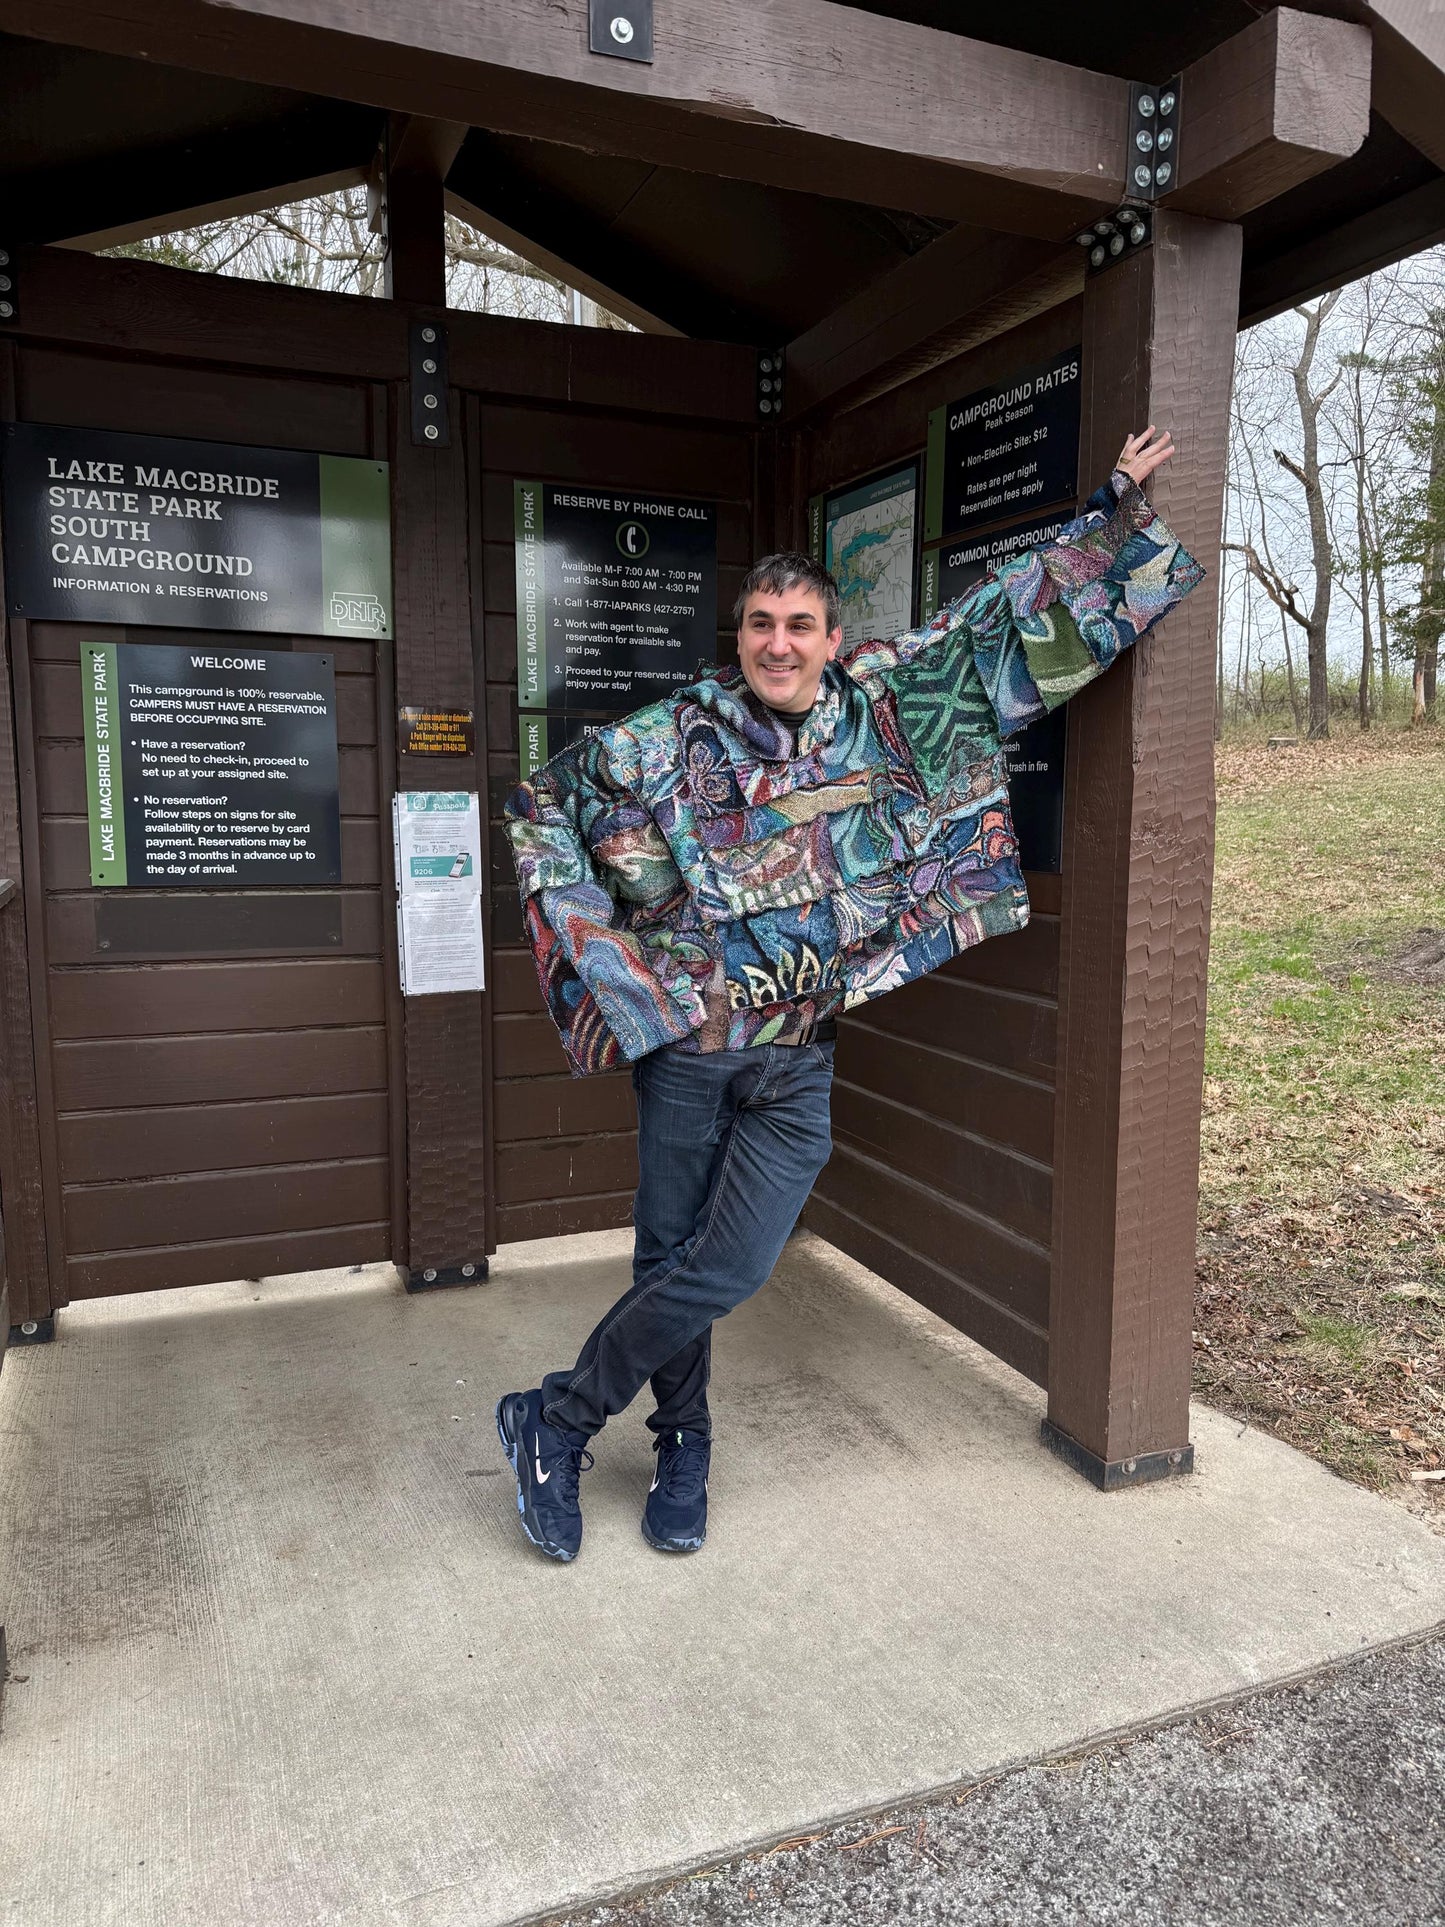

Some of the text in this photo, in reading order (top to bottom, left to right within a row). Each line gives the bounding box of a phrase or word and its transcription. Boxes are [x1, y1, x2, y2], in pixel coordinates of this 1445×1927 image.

[950, 362, 1078, 431] CAMPGROUND RATES
[985, 404, 1033, 431] Peak Season
[967, 427, 1048, 467] Non-Electric Site: $12
[48, 458, 279, 499] LAKE MACBRIDE
[967, 462, 1037, 495] Rates are per night
[49, 487, 222, 520] STATE PARK
[960, 479, 1043, 516] Reservation fees apply
[553, 494, 707, 520] RESERVE BY PHONE CALL
[50, 515, 151, 542] SOUTH
[51, 543, 252, 577] CAMPGROUND
[949, 544, 989, 567] COMMON
[561, 562, 602, 573] Available
[605, 564, 622, 574] M-F
[625, 566, 643, 577] 7:00
[645, 567, 659, 577] AM
[668, 569, 686, 579] 7:00
[688, 571, 702, 581] PM
[52, 578, 268, 602] INFORMATION & RESERVATIONS
[563, 575, 580, 585] and
[584, 577, 619, 588] Sat-Sun
[622, 579, 640, 589] 8:00
[642, 580, 656, 590] AM
[665, 582, 684, 592] 4:30
[686, 583, 699, 593] PM
[926, 562, 934, 602] PARK
[524, 491, 537, 692] LAKE MACBRIDE STATE PARK
[331, 600, 385, 623] DNR
[553, 598, 695, 617] 1. Call 1-877-IAPARKS (427-2757)
[554, 619, 669, 634] 2. Work with agent to make
[566, 632, 681, 648] reservation for available site
[566, 645, 601, 657] and pay.
[191, 656, 266, 670] WELCOME
[554, 665, 562, 674] 3.
[566, 666, 602, 677] Proceed
[604, 669, 611, 677] to
[613, 670, 632, 681] your
[634, 669, 670, 679] reserved
[672, 671, 686, 680] site
[129, 684, 325, 701] This campground is 100% reservable.
[566, 679, 631, 690] enjoy your stay!
[130, 699, 326, 715] CAMPERS MUST HAVE A RESERVATION
[130, 714, 266, 726] BEFORE OCCUPYING SITE.
[141, 740, 168, 749] Have
[180, 741, 245, 750] reservation?
[529, 725, 538, 759] PARK
[93, 652, 114, 861] LAKE MACBRIDE STATE PARK
[142, 754, 309, 767] No need to check-in, proceed to
[142, 768, 289, 780] set up at your assigned site.
[1009, 761, 1048, 772] trash in fire
[144, 796, 228, 805] No reservation?
[145, 809, 296, 822] Follow steps on signs for site
[145, 823, 200, 835] availability
[217, 824, 228, 833] to
[231, 825, 269, 833] reserve
[272, 824, 284, 835] by
[287, 824, 310, 833] card
[146, 837, 306, 848] payment. Reservations may be
[146, 851, 315, 861] made 3 months in advance up to
[147, 864, 237, 875] the day of arrival.
